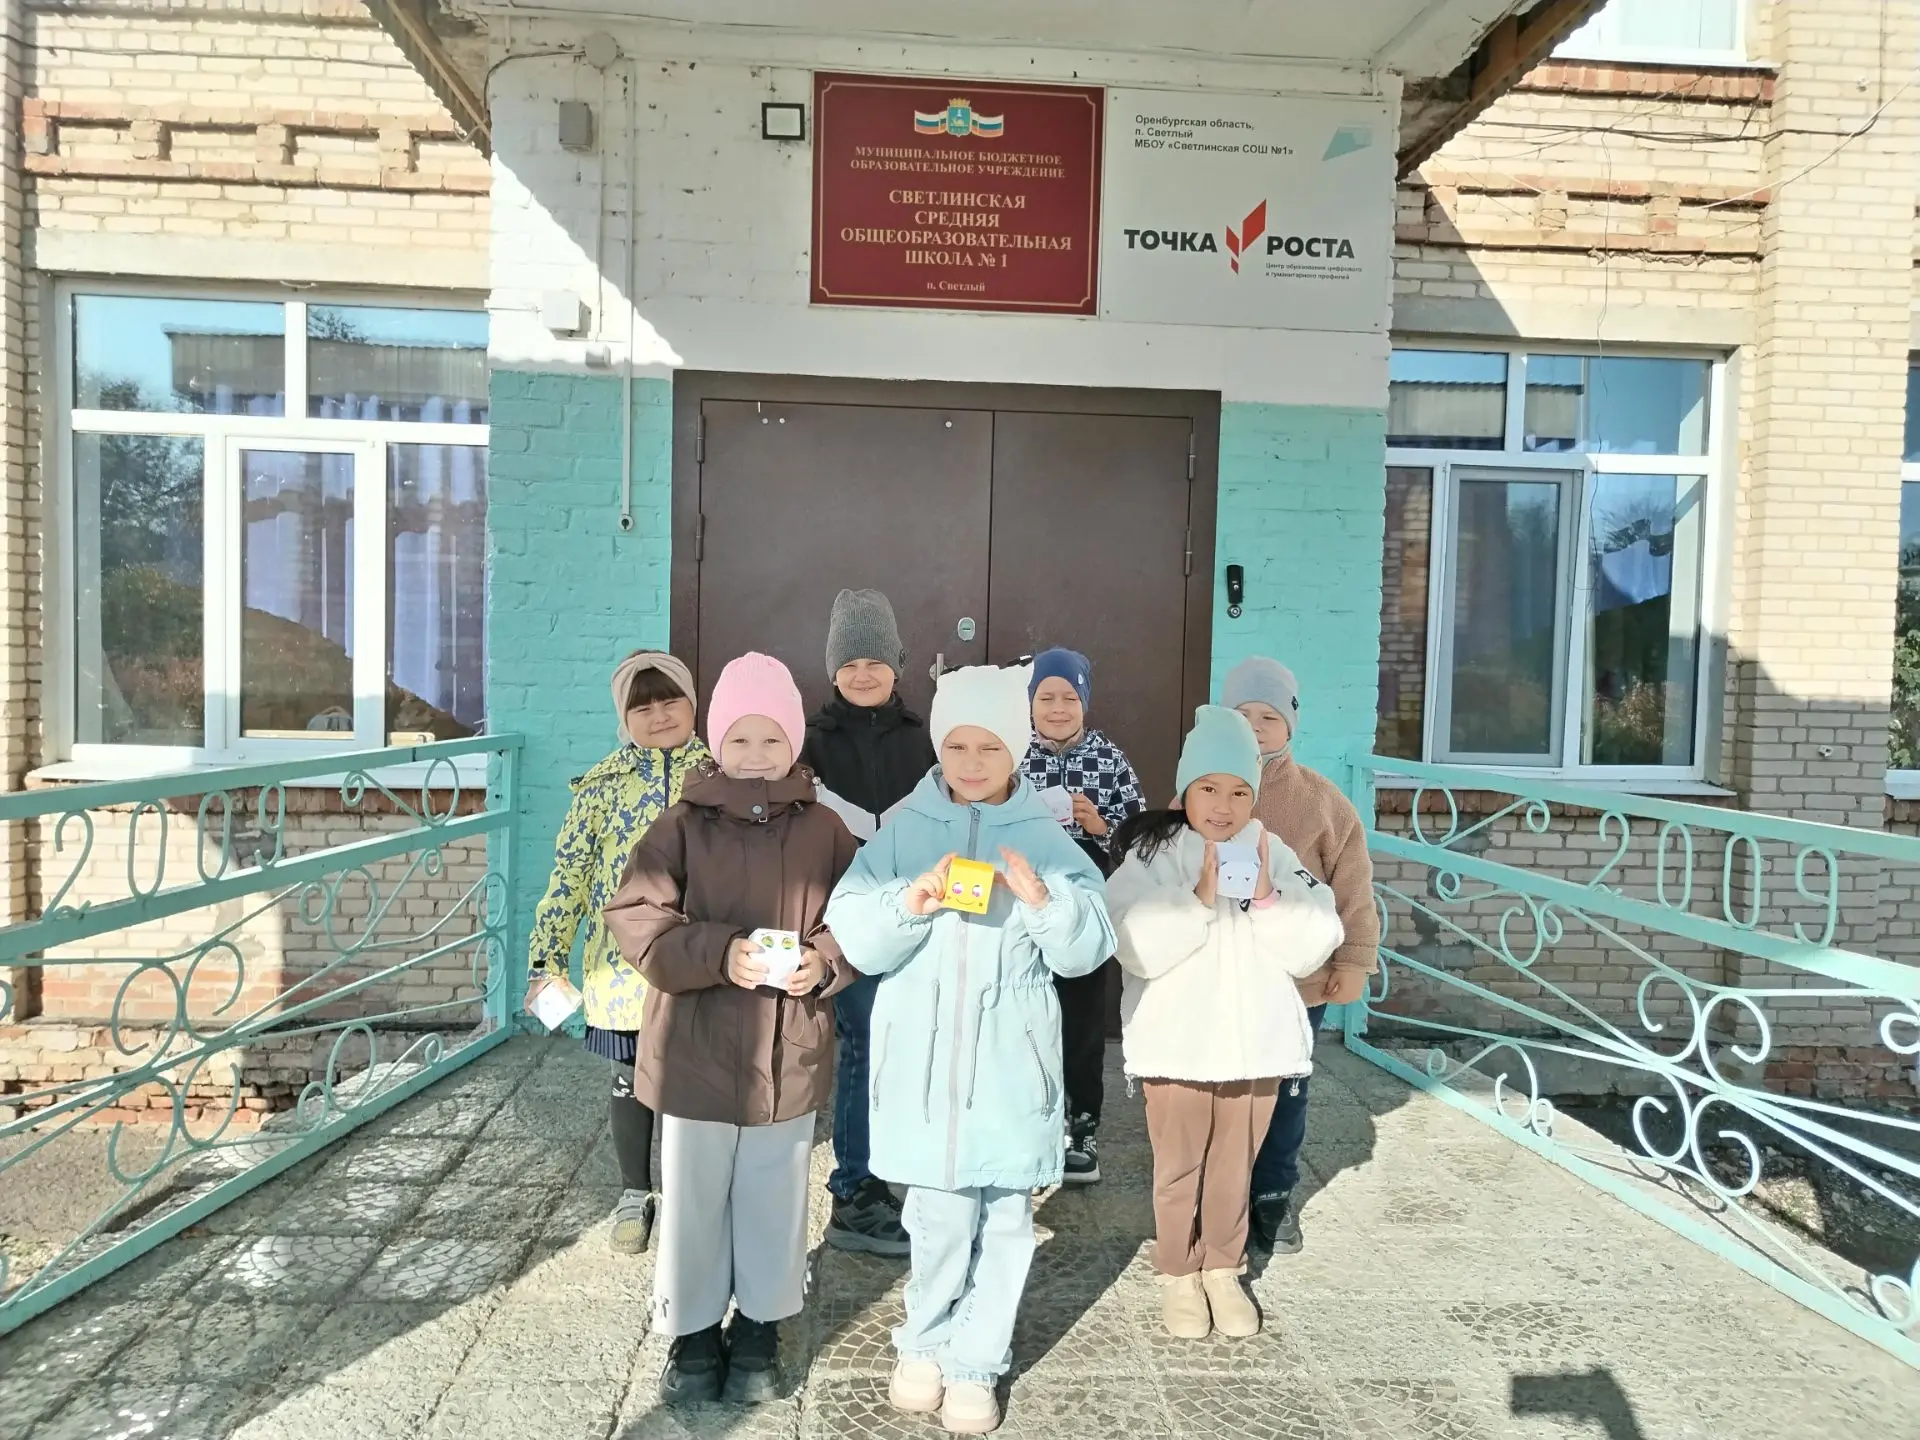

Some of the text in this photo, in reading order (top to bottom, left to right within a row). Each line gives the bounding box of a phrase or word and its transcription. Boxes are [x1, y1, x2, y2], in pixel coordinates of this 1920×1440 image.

[1135, 114, 1255, 131] Оренбургская область,
[1135, 127, 1193, 139] п. Светлый
[855, 146, 1062, 165] МУНИЦИПАЛЬНОЕ БЮДЖЕТНОЕ
[1134, 139, 1165, 149] МБОУ
[1168, 140, 1240, 153] «Светлинская
[1243, 144, 1268, 155] СОШ
[850, 159, 1066, 178] ОБРАЗОВАТЕЛЬНОЕ УЧРЕЖДЕНИЕ
[889, 189, 1026, 209] СВЕТЛИНСКАЯ
[914, 210, 1000, 228] СРЕДНЯЯ
[840, 227, 1072, 251] ОБЩЕОБРАЗОВАТЕЛЬНАЯ
[1123, 229, 1355, 259] ТОЧКА РОСТА
[905, 250, 1008, 268] ШКОЛА № 1
[927, 280, 986, 292] п. Светлый
[43, 780, 285, 922] 2009
[1587, 810, 1838, 948] 2009
